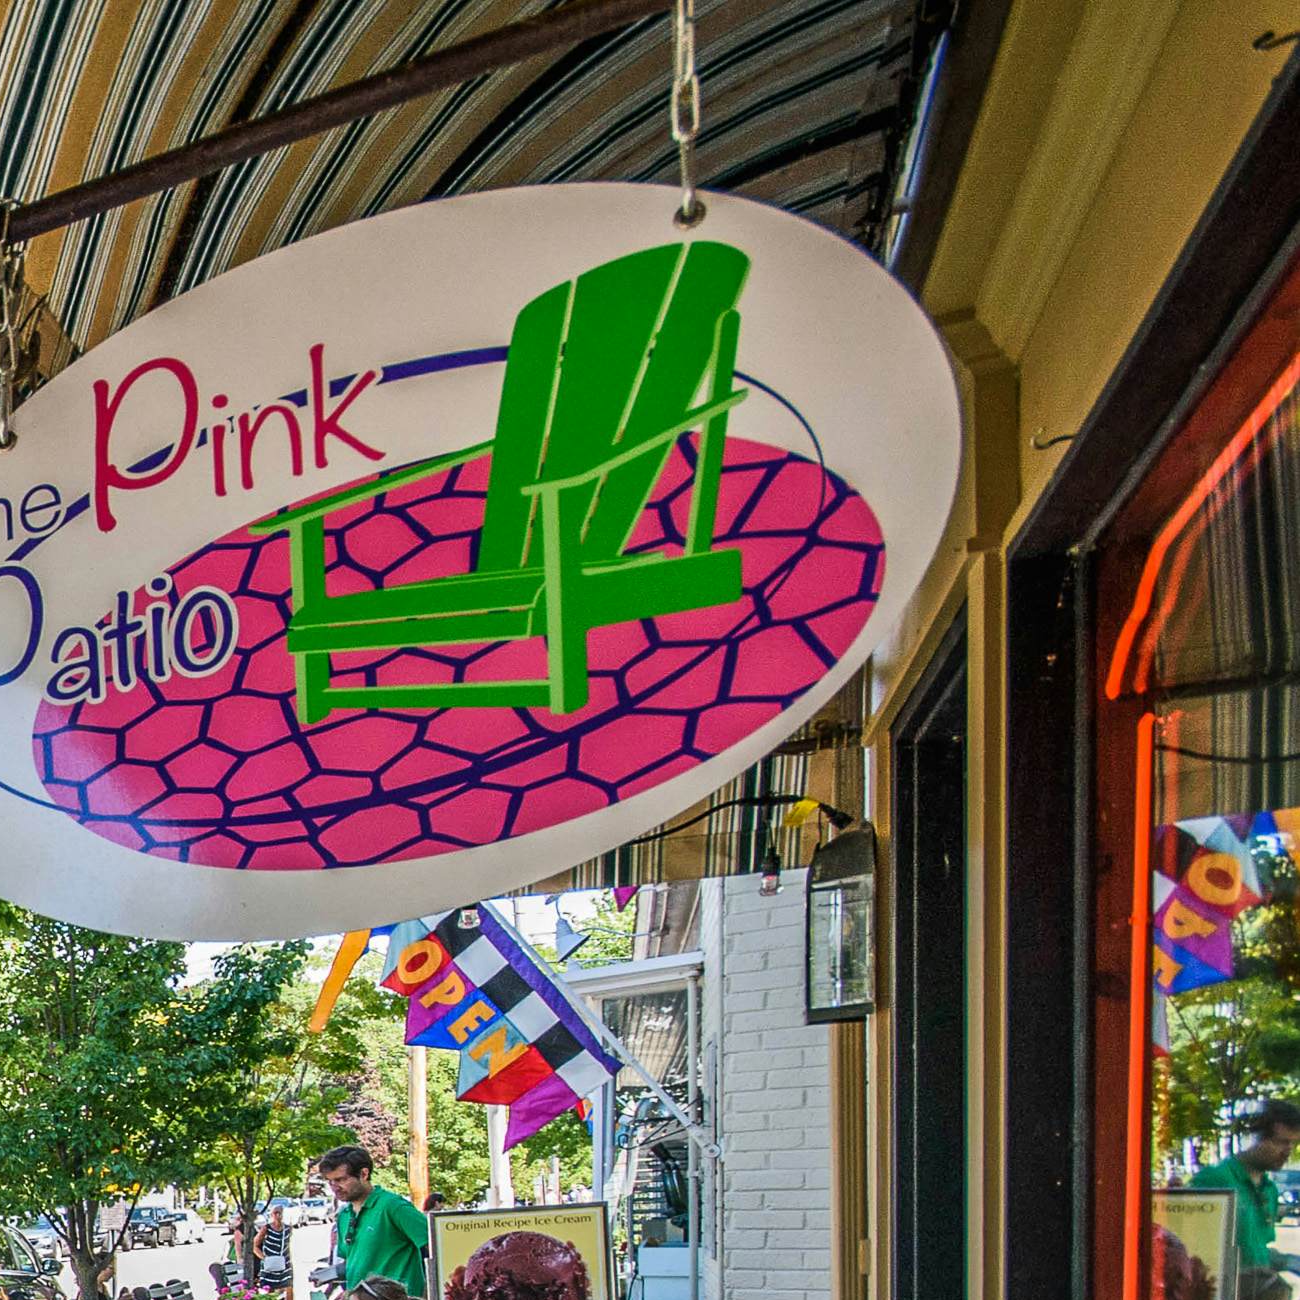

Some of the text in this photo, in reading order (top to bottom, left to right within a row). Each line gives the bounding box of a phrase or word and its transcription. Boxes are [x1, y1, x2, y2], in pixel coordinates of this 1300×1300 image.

[93, 343, 387, 533] Pink
[397, 939, 530, 1080] OPEN
[445, 1214, 592, 1233] Original Recipe Ice Cream
